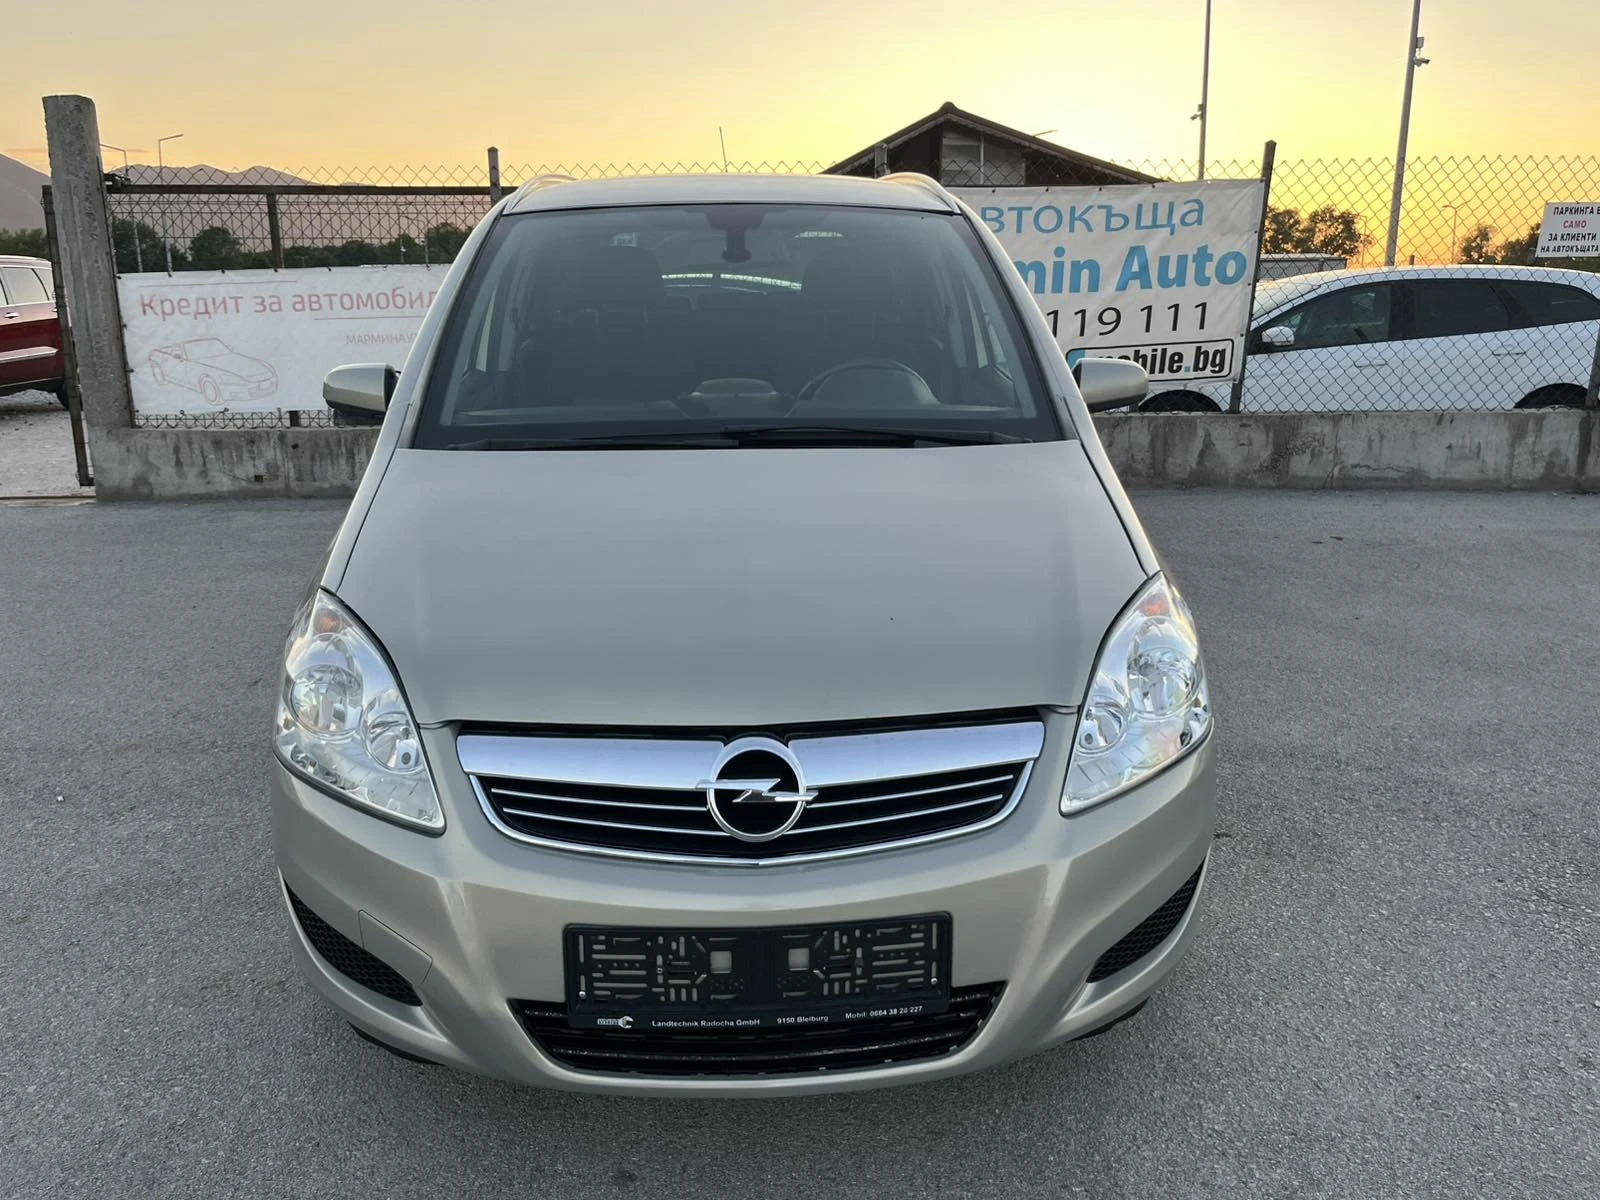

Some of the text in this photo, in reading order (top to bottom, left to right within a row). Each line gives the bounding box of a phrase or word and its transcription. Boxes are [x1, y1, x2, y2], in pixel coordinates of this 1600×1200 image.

[1553, 206, 1594, 215] ПАРКИНГА
[1563, 220, 1587, 229] САМО
[1548, 232, 1597, 241] ЗА КЛИЕНТИ
[1541, 244, 1599, 253] НА АВТОКЪЩАТА
[1115, 244, 1248, 291] Auto
[140, 293, 245, 322] Кредит
[253, 295, 283, 314] за
[1140, 302, 1208, 334] 111
[700, 1019, 734, 1027] Radocha
[735, 1019, 760, 1027] GmbH
[777, 1016, 795, 1024] 9150
